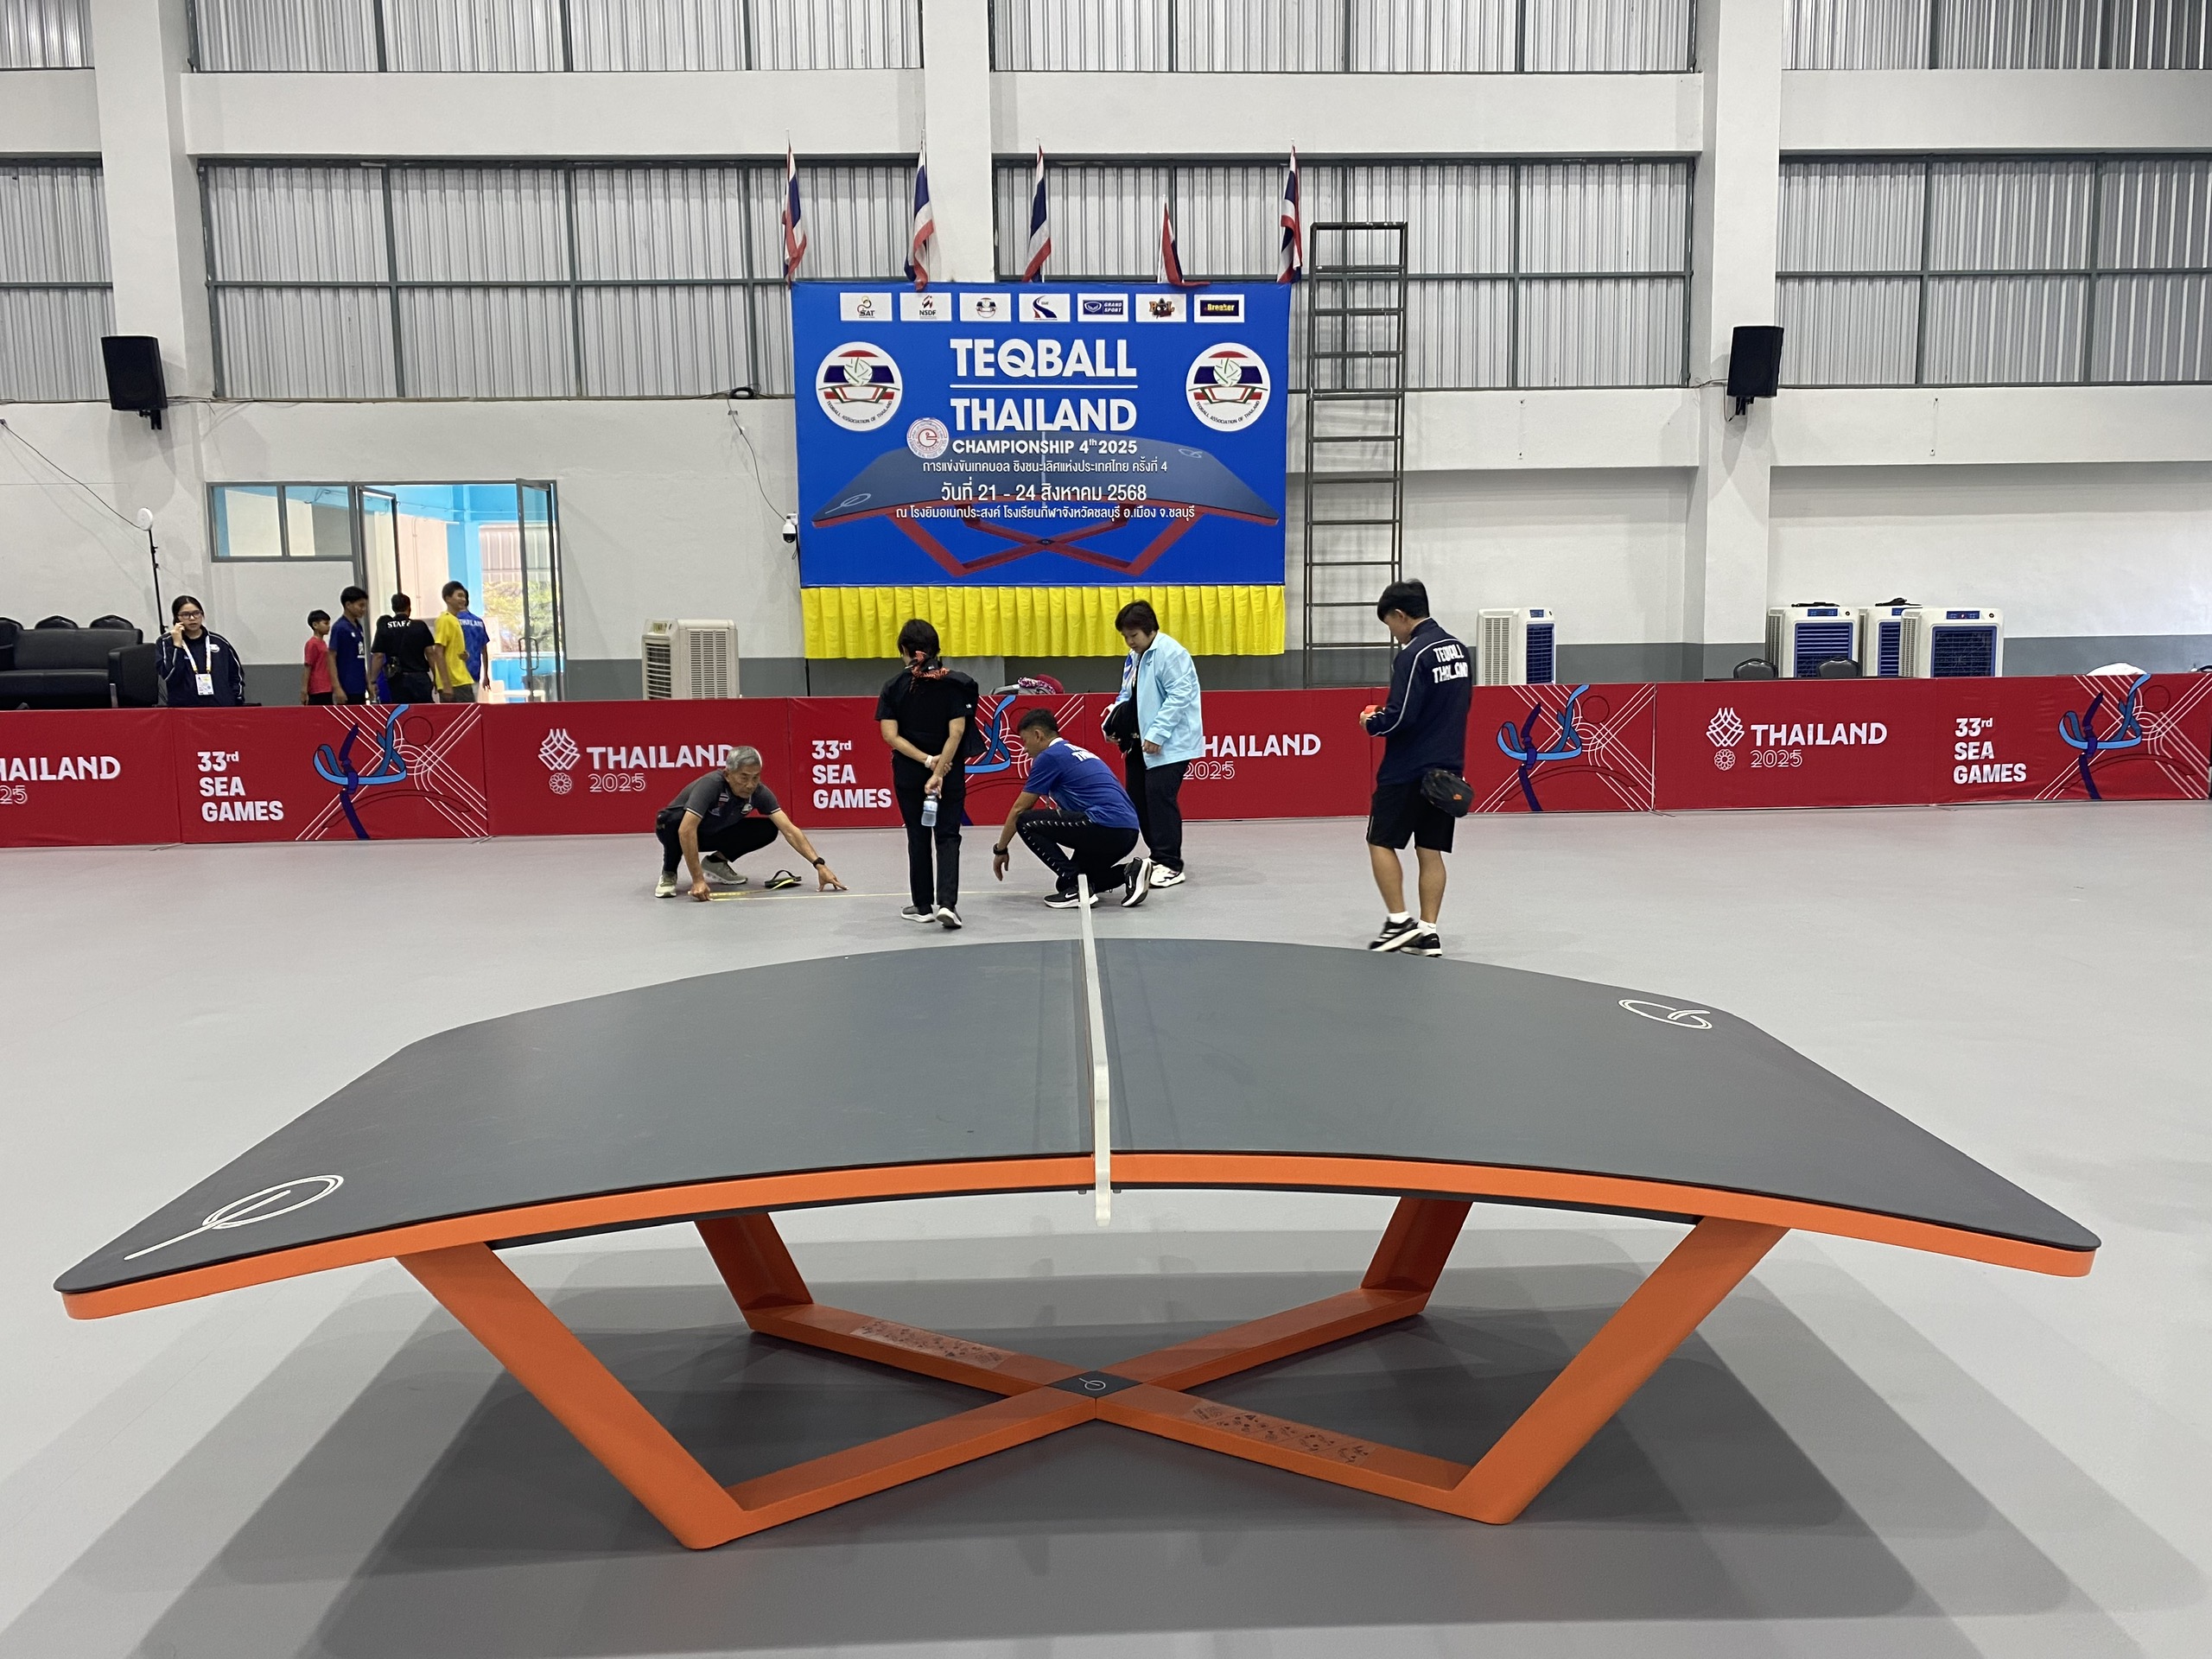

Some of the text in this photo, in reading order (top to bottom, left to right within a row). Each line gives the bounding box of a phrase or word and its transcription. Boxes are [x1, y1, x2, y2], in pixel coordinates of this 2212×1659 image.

[950, 338, 1137, 378] TEQBALL
[842, 415, 870, 424] ASSOCIATION
[877, 400, 893, 418] THAILAND
[950, 398, 1137, 431] THAILAND
[1210, 415, 1238, 424] ASSOCIATION
[1244, 400, 1261, 418] THAILAND
[952, 438, 1138, 454] CHAMPIONSHIP 4th 2025
[923, 456, 1168, 473] การแข่งขันเทคบอล ชิงชนะเลิศแห่งประเทศไทย ครั้งที่ 4
[941, 476, 973, 501] วันที่
[977, 484, 996, 501] 21
[1015, 484, 1036, 501] 24
[1040, 483, 1102, 501] สิงหาคม
[1107, 484, 1147, 501] 2568
[896, 505, 1195, 522] ณ โรงยิมอเนกประสงค์ โรงเรียนกีฬาจังหวัดชลบุรี อ.เมือง จ.ชลบุรี
[1750, 722, 1888, 747] THAILAND
[1955, 716, 1993, 738] 33rd
[811, 740, 852, 760] 33rd
[1202, 734, 1321, 758] HAILAND
[1954, 741, 1994, 760] SEA
[197, 750, 239, 772] 33rd
[1750, 749, 1803, 768] 2025
[811, 764, 856, 785] SEA
[1183, 760, 1236, 780] 2025
[1953, 762, 2027, 785] GAMES
[199, 776, 246, 797] SEA
[588, 772, 646, 792] 2025
[813, 788, 892, 810] GAMES
[201, 800, 284, 823] GAMES
